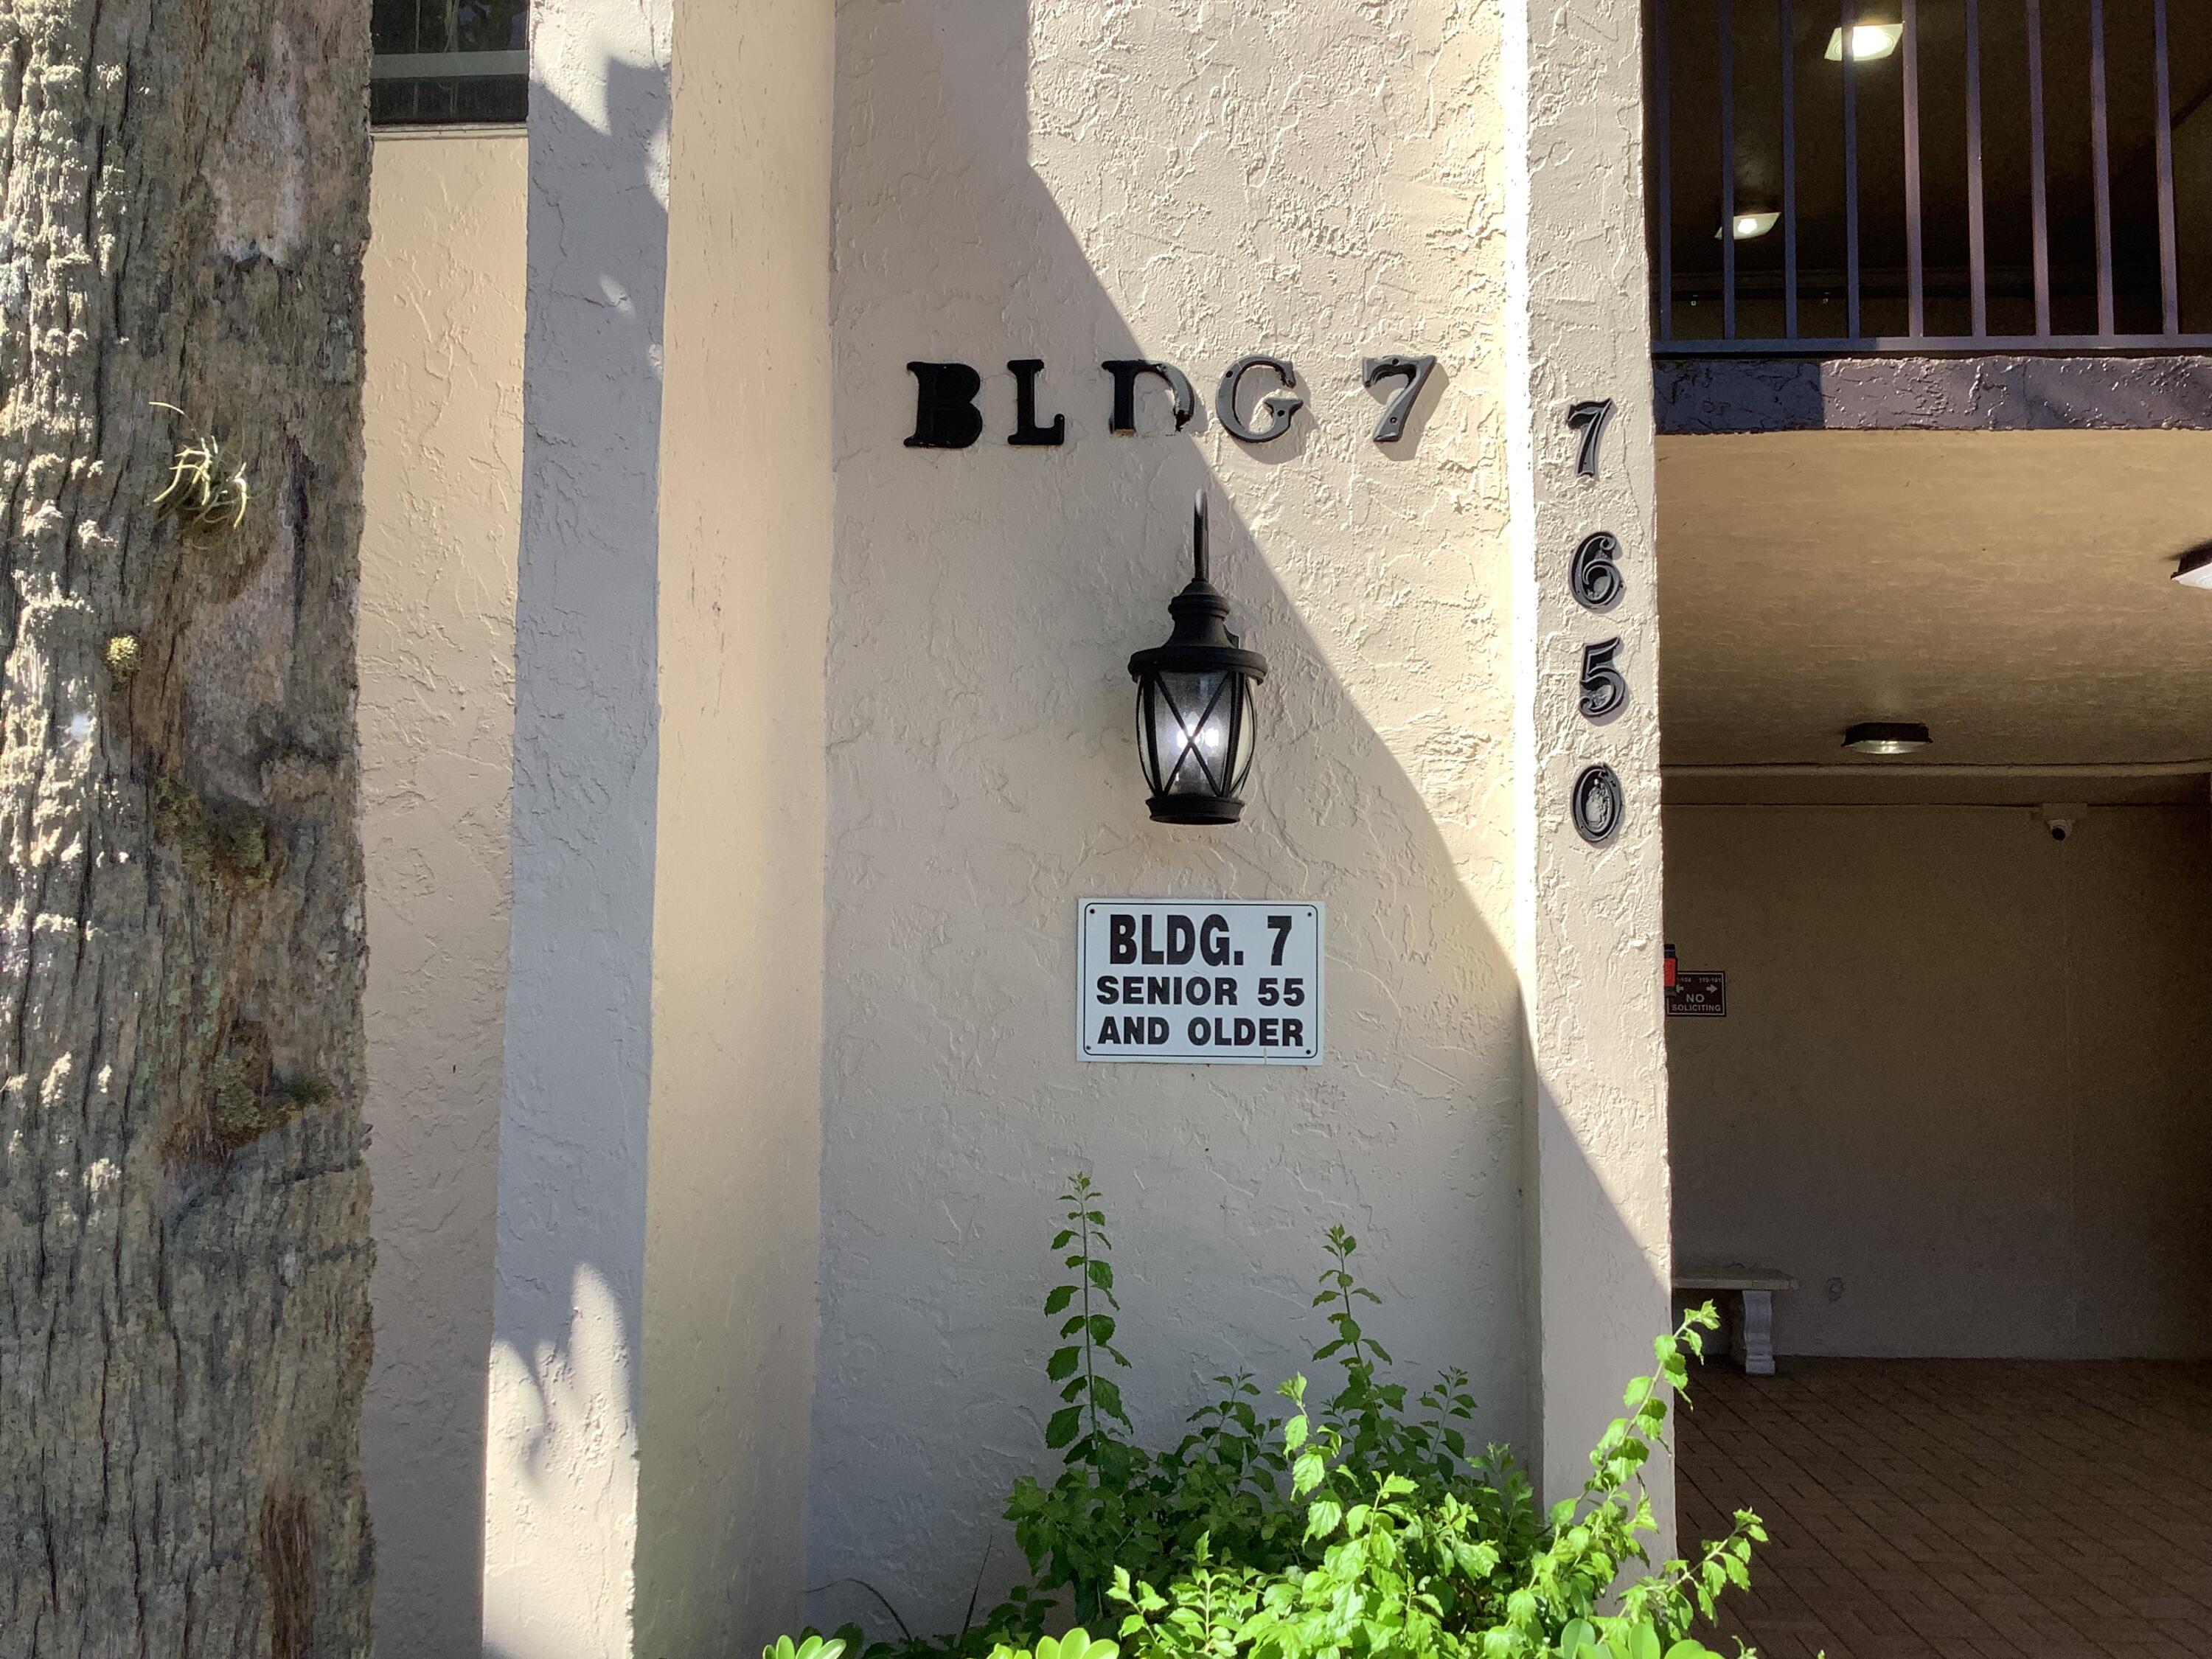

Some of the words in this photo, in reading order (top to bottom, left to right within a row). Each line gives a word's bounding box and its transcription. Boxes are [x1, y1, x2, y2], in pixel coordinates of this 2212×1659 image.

[903, 354, 1304, 448] BLDG
[1362, 354, 1437, 442] 7
[1567, 398, 1625, 844] 7650
[1110, 914, 1244, 967] BLDG.
[1267, 915, 1292, 966] 7
[1096, 975, 1238, 1006] SENIOR
[1258, 978, 1305, 1006] 55
[1686, 994, 1705, 1003] NO
[1672, 1004, 1721, 1012] SOLICITING
[1097, 1016, 1169, 1045] AND
[1188, 1017, 1304, 1047] OLDER
